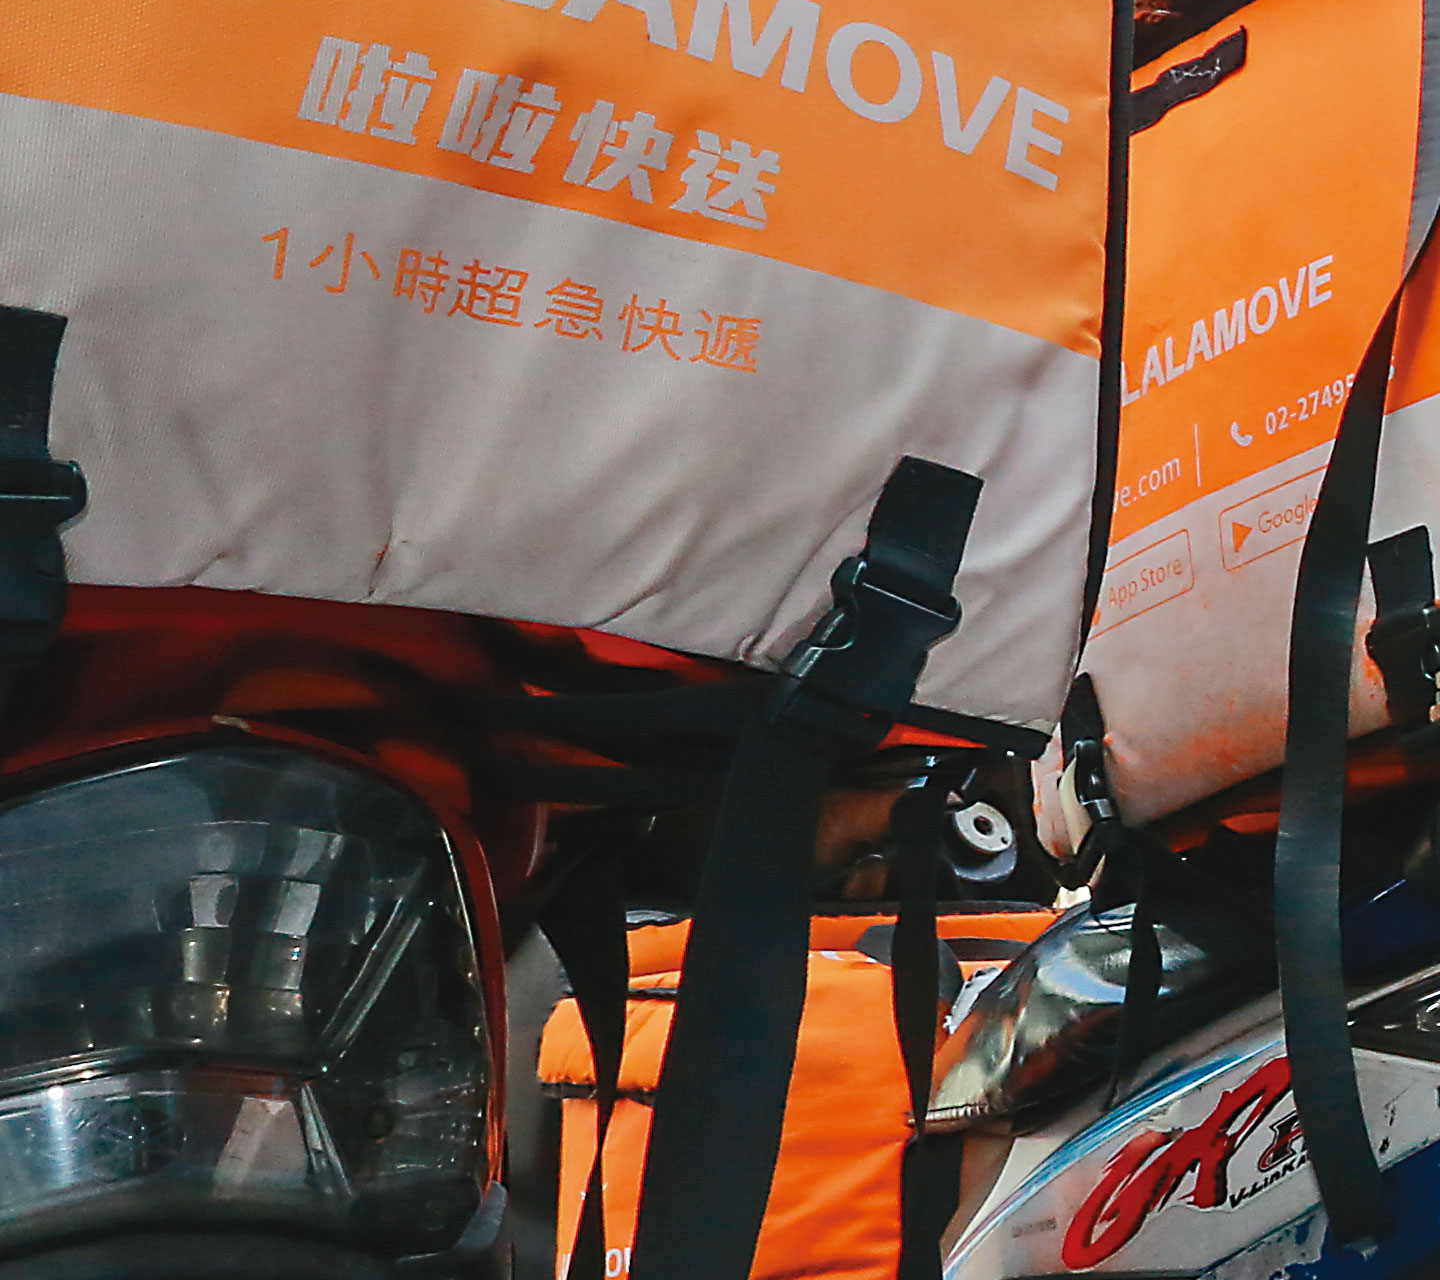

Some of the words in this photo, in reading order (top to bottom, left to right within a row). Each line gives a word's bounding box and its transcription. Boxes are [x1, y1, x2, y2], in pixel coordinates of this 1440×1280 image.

[297, 35, 781, 230] 啦啦快送
[259, 224, 762, 376] 1小時超急快遞
[1121, 255, 1333, 407] LALAMOVE
[1113, 457, 1181, 513] e.com
[1108, 577, 1139, 607] App
[1139, 559, 1182, 593] Store
